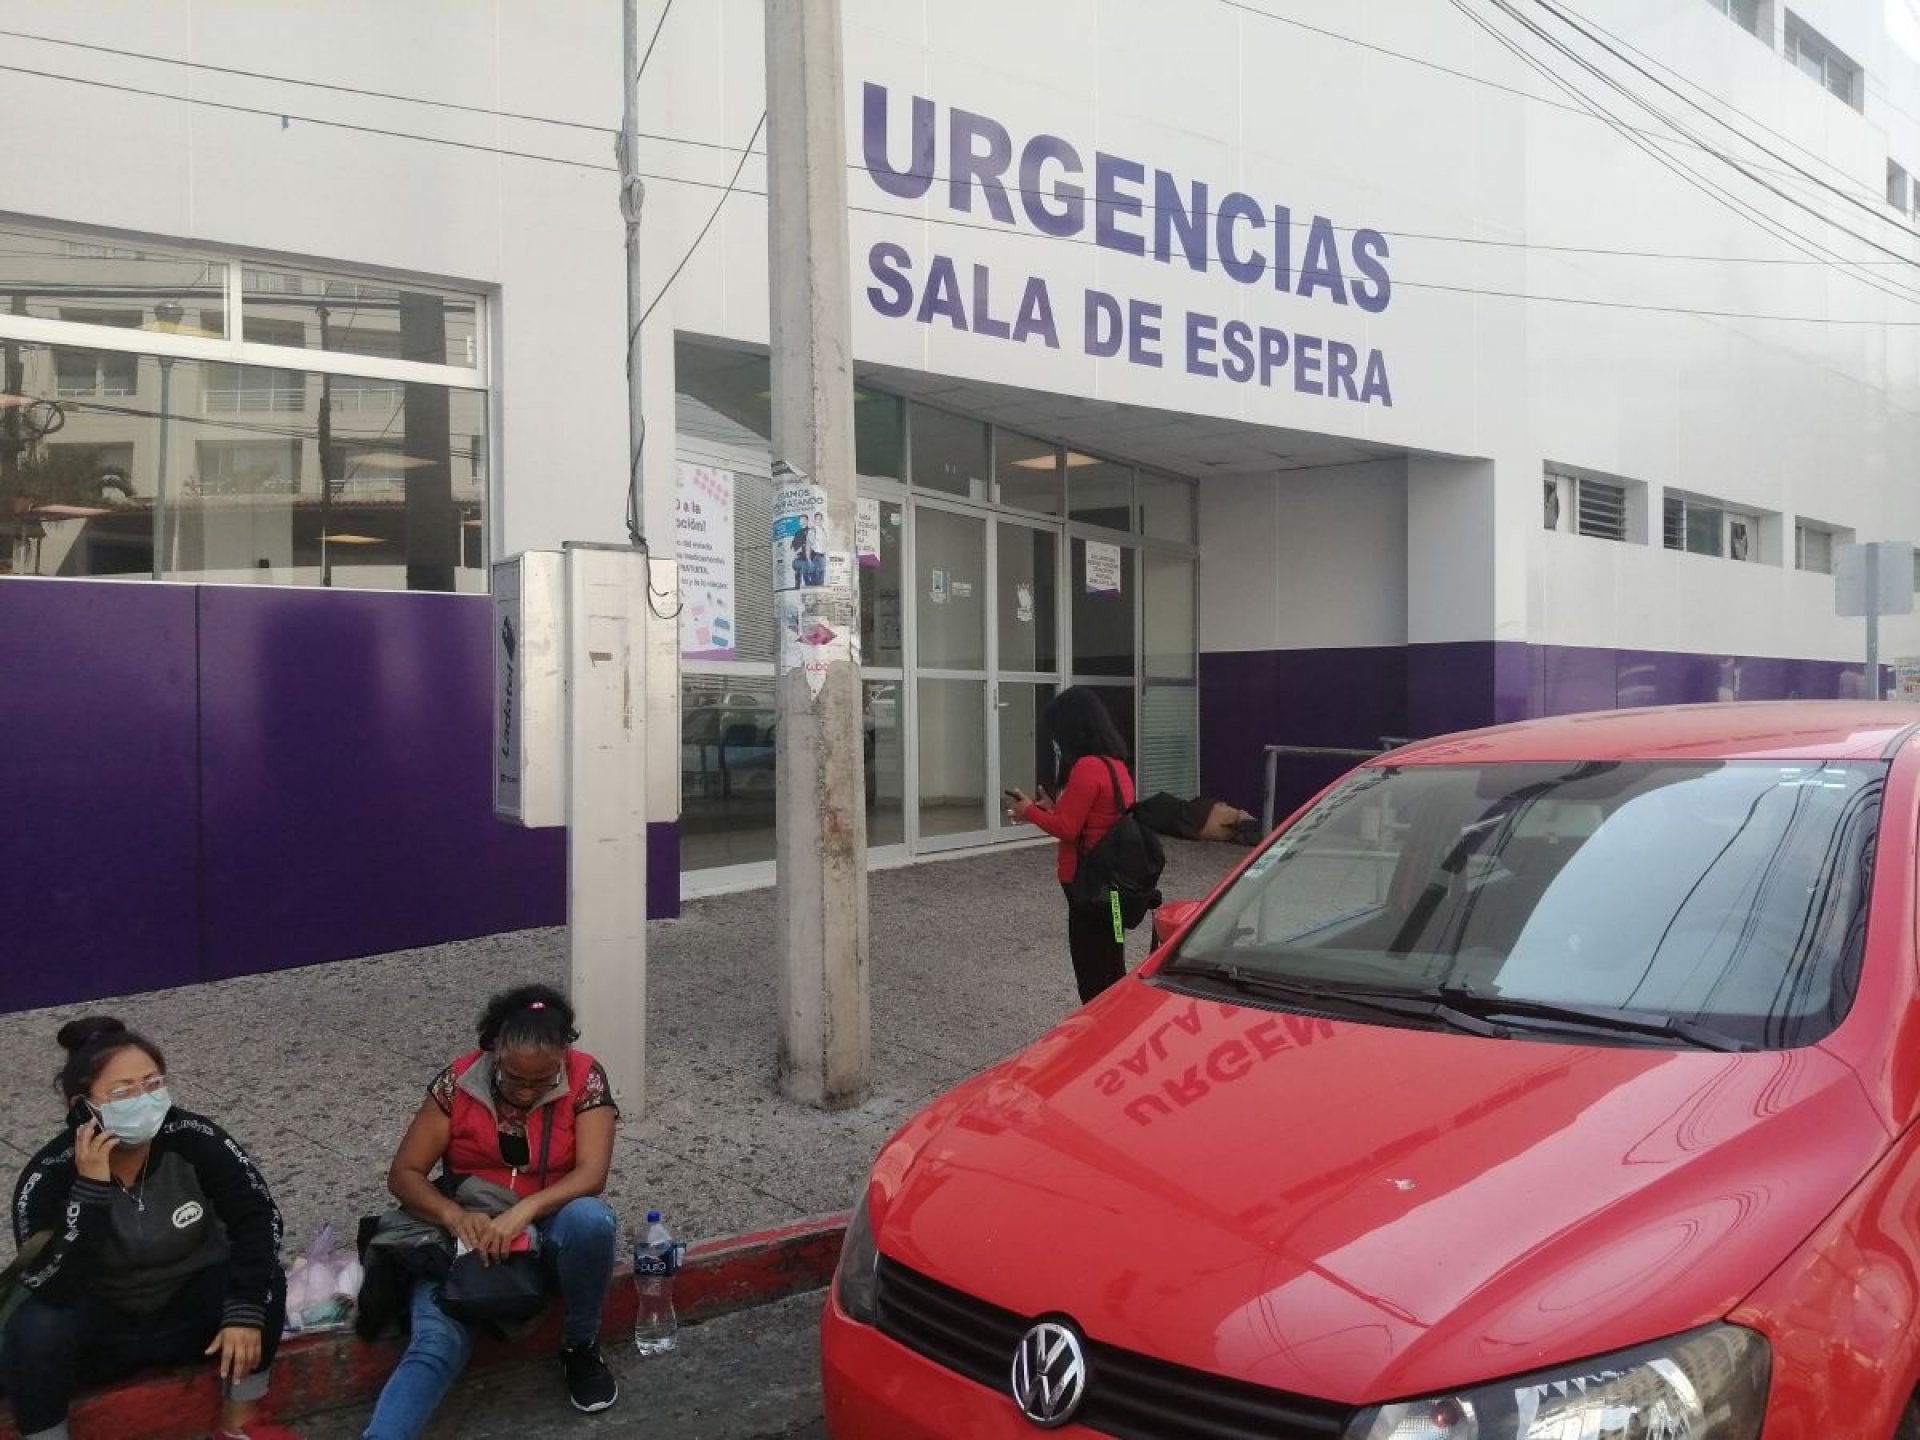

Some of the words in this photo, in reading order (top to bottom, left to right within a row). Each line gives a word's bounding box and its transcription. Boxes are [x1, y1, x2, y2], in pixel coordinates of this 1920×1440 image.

[863, 81, 1392, 314] URGENCIAS
[866, 242, 1060, 349] SALA
[1084, 288, 1163, 369] DE
[1186, 311, 1393, 408] ESPERA
